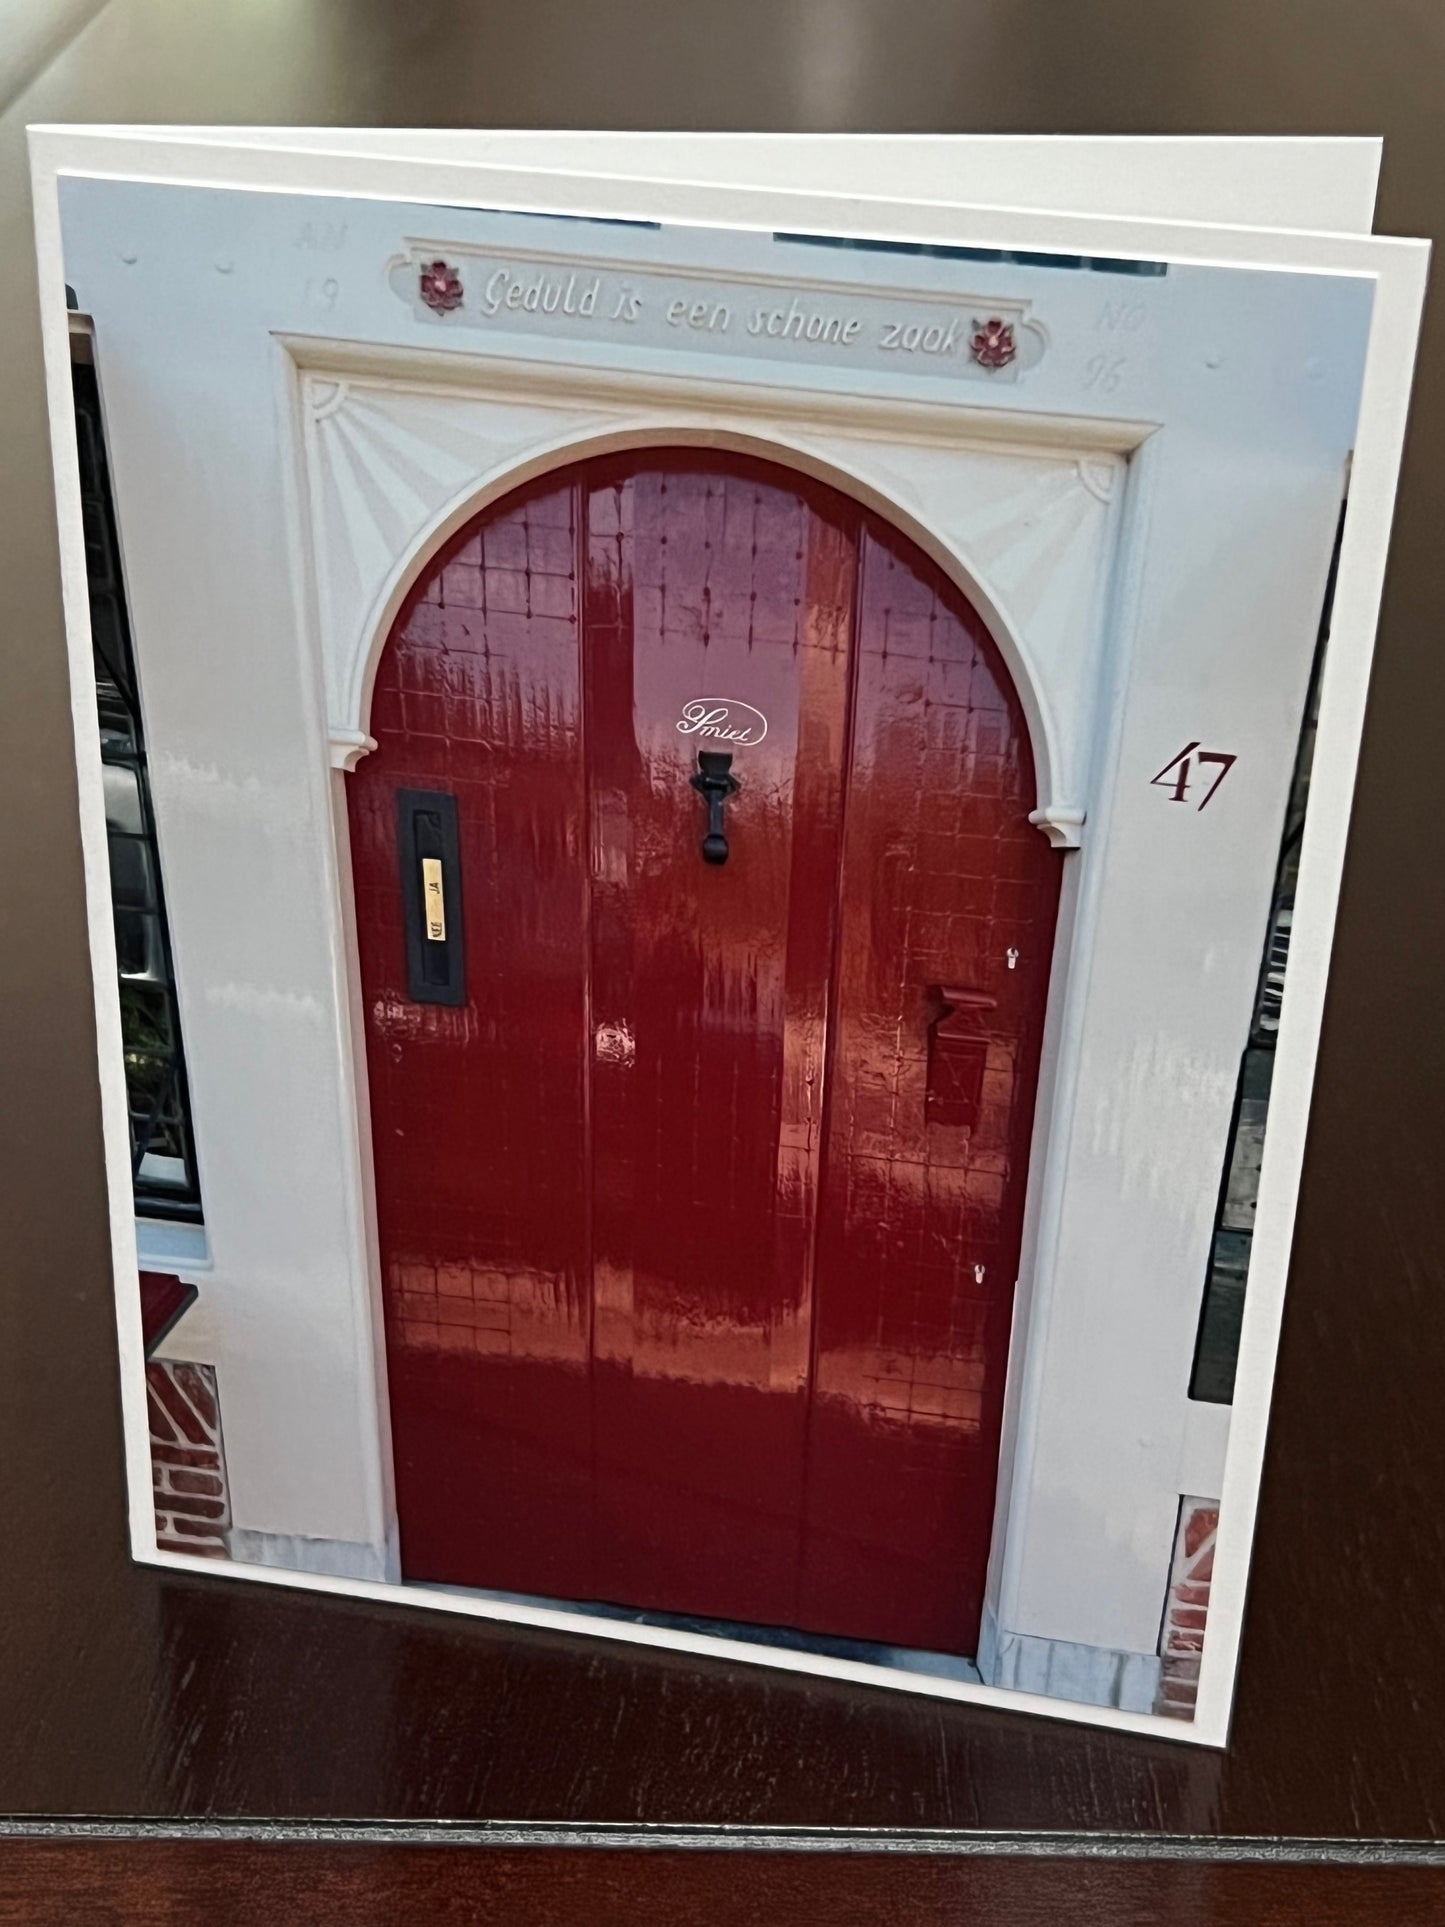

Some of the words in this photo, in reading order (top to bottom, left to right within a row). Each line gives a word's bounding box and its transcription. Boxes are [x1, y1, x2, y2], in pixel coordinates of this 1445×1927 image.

[481, 267, 601, 316] Geduld
[611, 279, 642, 322] is
[666, 300, 731, 332] een
[747, 297, 861, 345] schone
[1149, 741, 1238, 812] 47
[428, 881, 441, 895] JA
